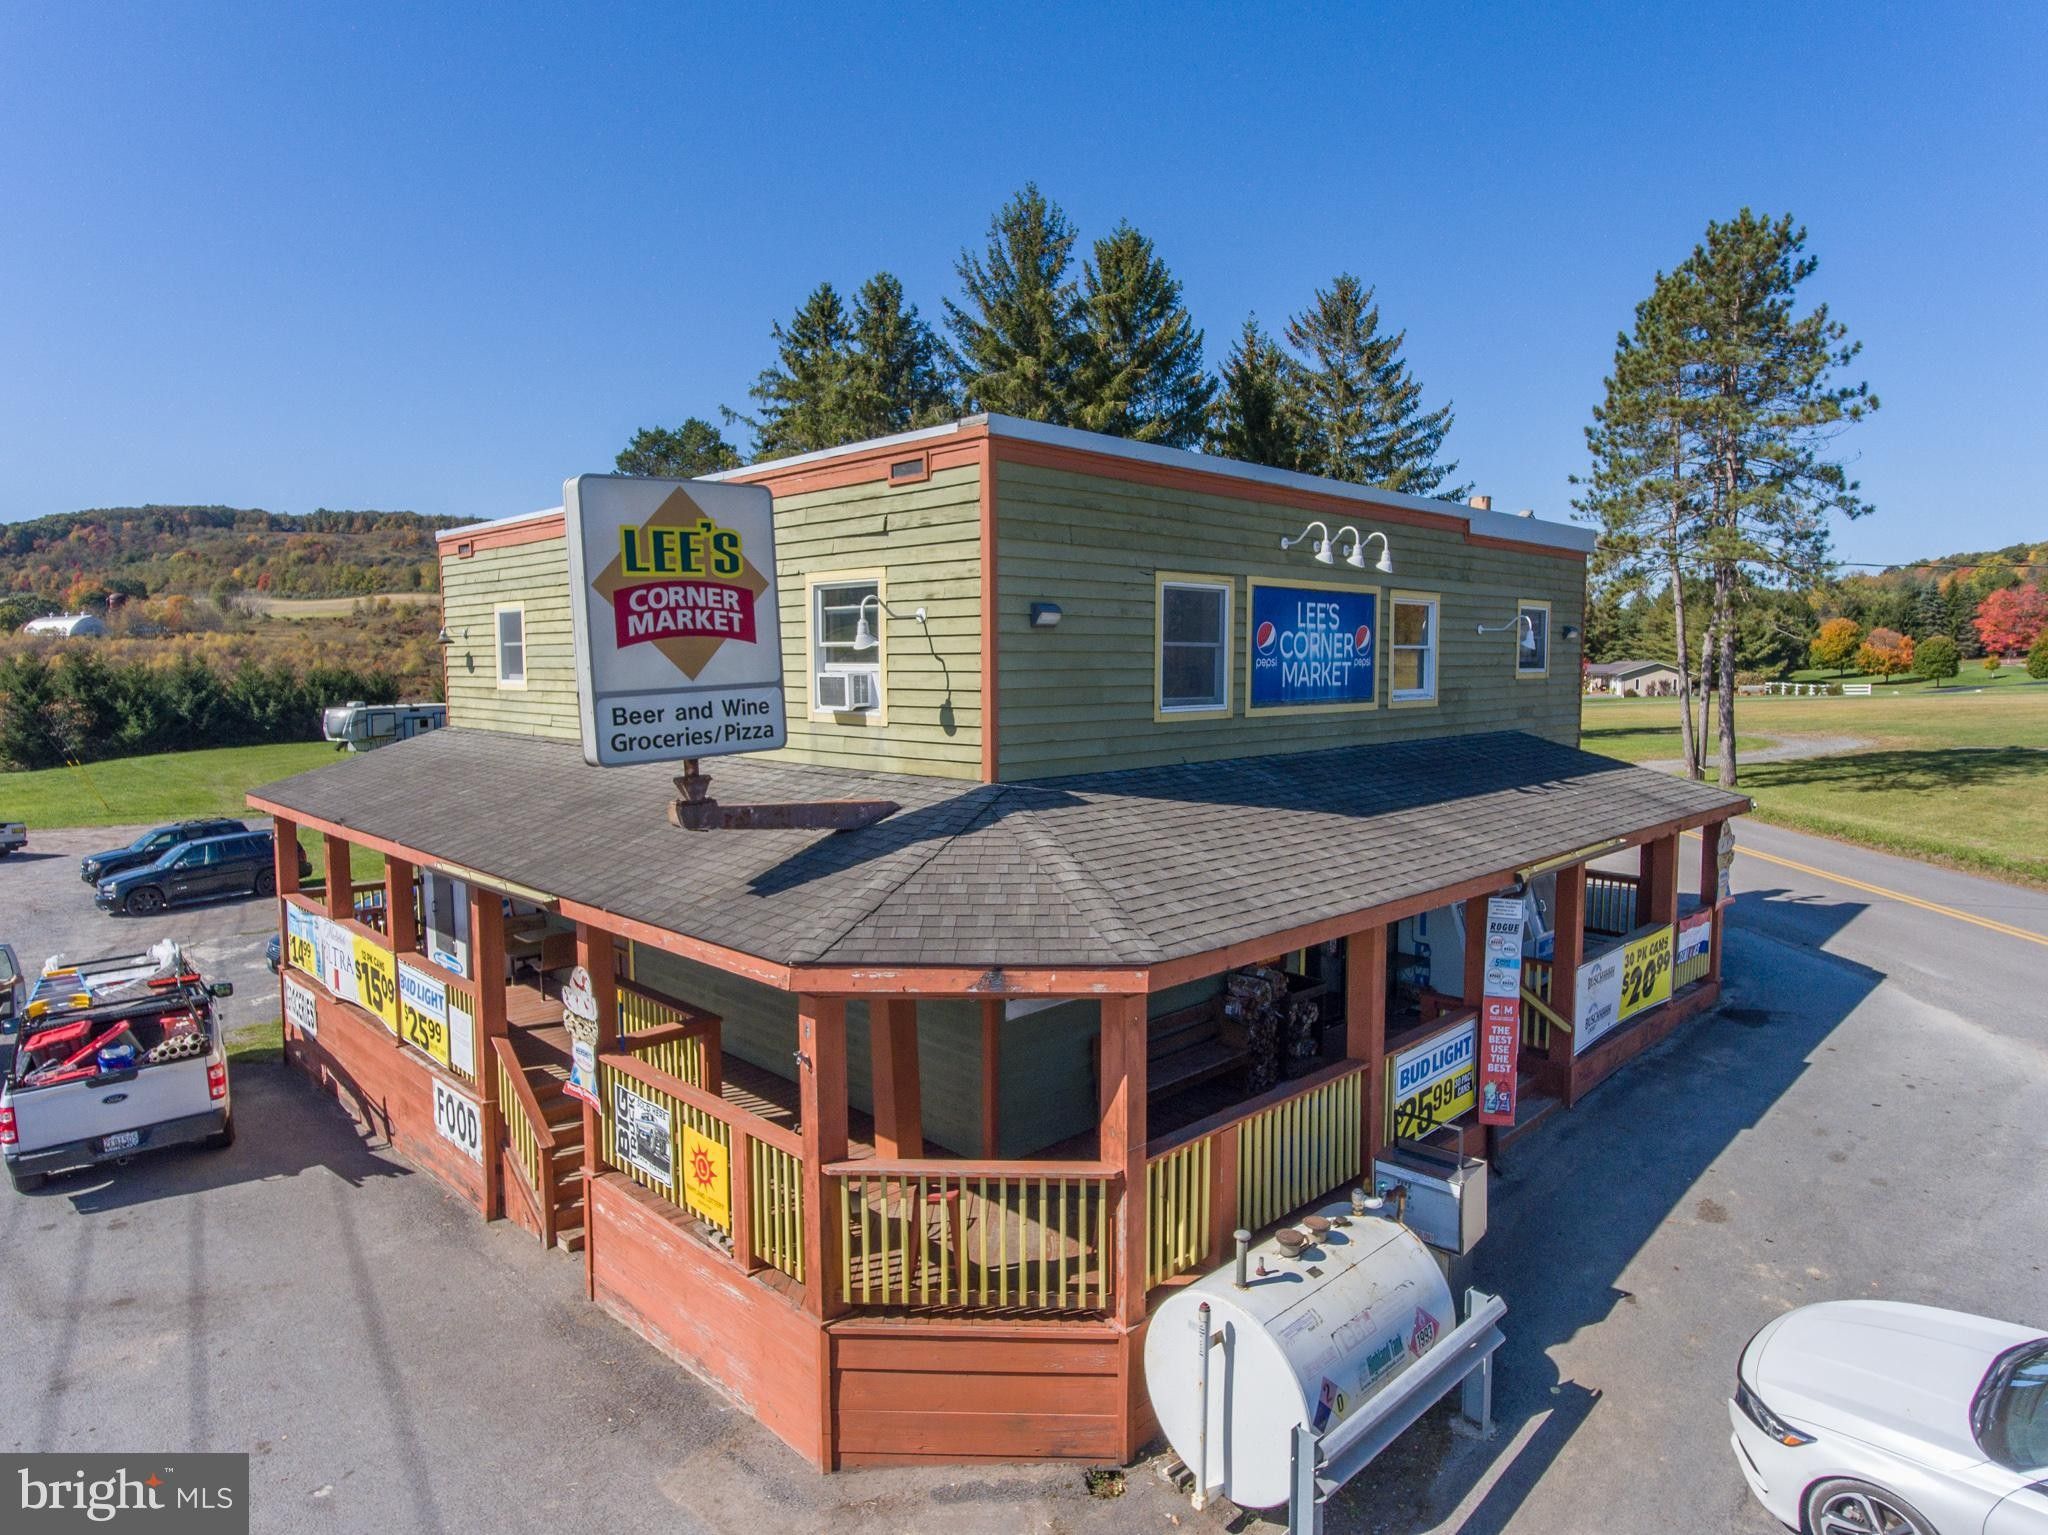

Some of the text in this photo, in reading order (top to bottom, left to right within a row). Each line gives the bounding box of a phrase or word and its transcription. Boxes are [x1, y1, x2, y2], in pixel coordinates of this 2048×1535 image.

[620, 519, 743, 578] LEE'S
[629, 586, 740, 612] CORNER
[628, 609, 743, 637] MARKET
[1297, 601, 1340, 631] LEE'S
[1280, 630, 1354, 660] CORNER
[1255, 657, 1278, 669] pepsi
[1281, 661, 1351, 688] MARKET
[1353, 657, 1372, 668] pepsi
[611, 698, 770, 727] Beer and Wine
[610, 722, 775, 753] Groceries/Pizza
[1490, 921, 1520, 931] ROGUE
[1624, 954, 1634, 968] 30
[1637, 946, 1647, 962] PK
[1649, 936, 1669, 956] CANS
[400, 974, 444, 1011] BUD LIGHT
[1488, 1035, 1513, 1044] BEST
[1491, 1025, 1510, 1035] THE
[1490, 1044, 1510, 1053] USE
[1490, 1054, 1510, 1064] THE
[1400, 1036, 1472, 1090] BUD LIGHT
[1487, 1064, 1511, 1073] BEST
[437, 1086, 477, 1149] FOOD
[636, 1097, 666, 1121] SOLD HERE
[617, 1087, 639, 1161] BIG TRUCK
[1417, 1324, 1433, 1347] 1993
[1323, 1383, 1333, 1403] 2
[1336, 1393, 1344, 1412] 0
